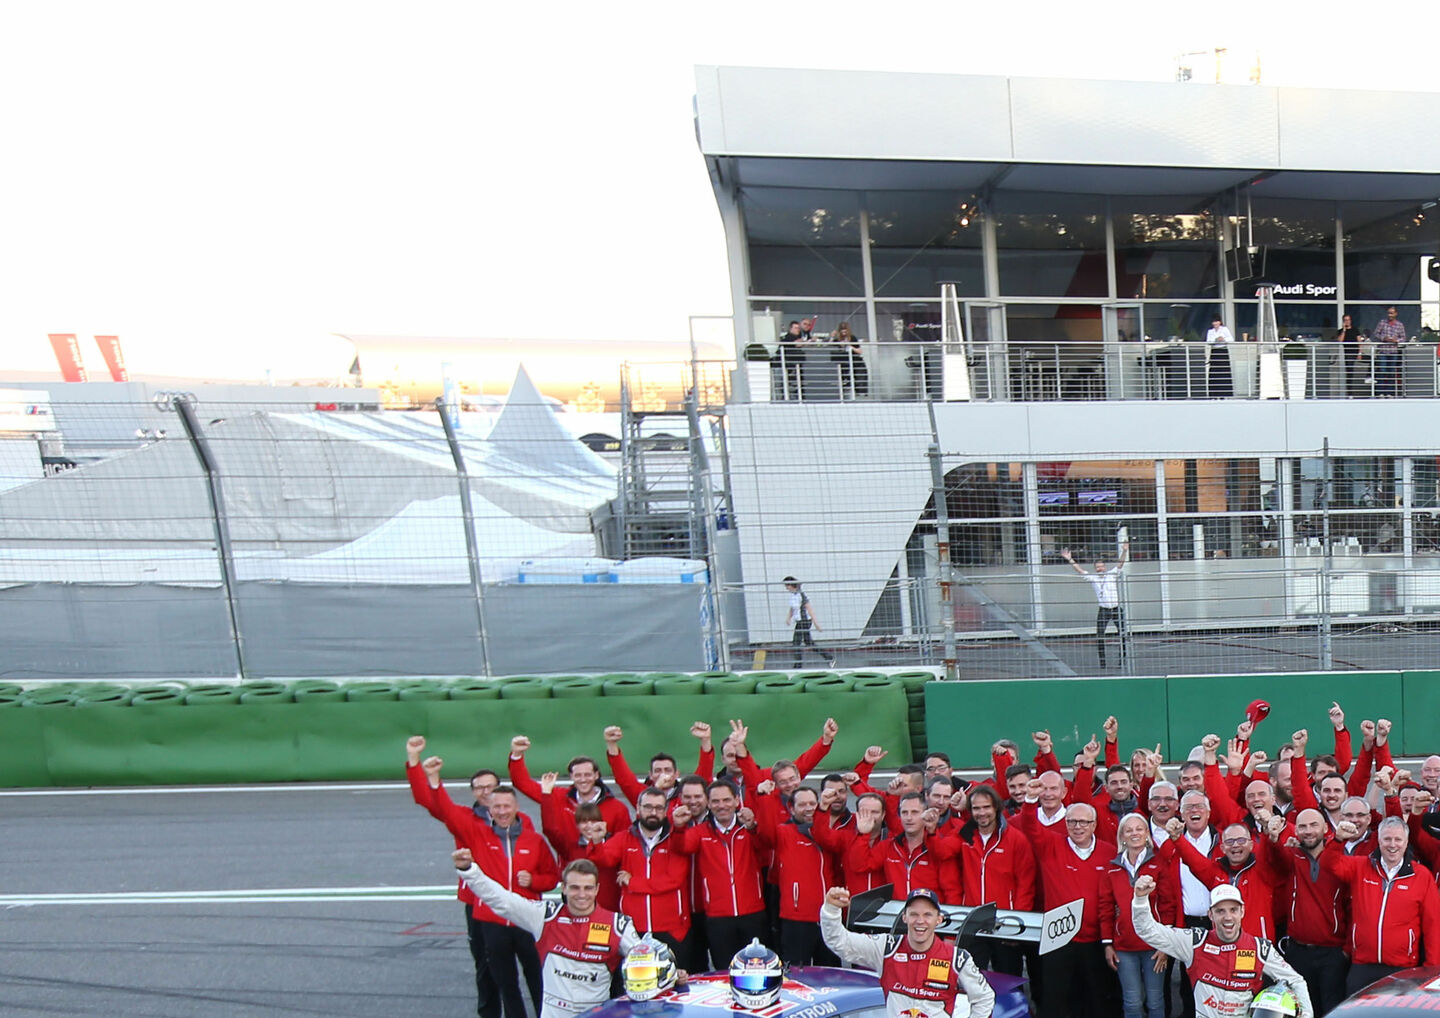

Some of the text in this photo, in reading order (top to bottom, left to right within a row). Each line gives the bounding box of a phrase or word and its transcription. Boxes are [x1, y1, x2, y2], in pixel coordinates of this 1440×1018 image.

[1273, 284, 1337, 296] Audi Spor
[590, 923, 610, 932] ADAC
[561, 948, 579, 957] Audi
[580, 951, 602, 960] Sport
[1237, 950, 1255, 958] ADAC
[930, 959, 949, 969] ADAC
[554, 968, 589, 982] PLAYBOY
[1211, 976, 1250, 989] Audi Sport
[919, 988, 941, 998] Sport
